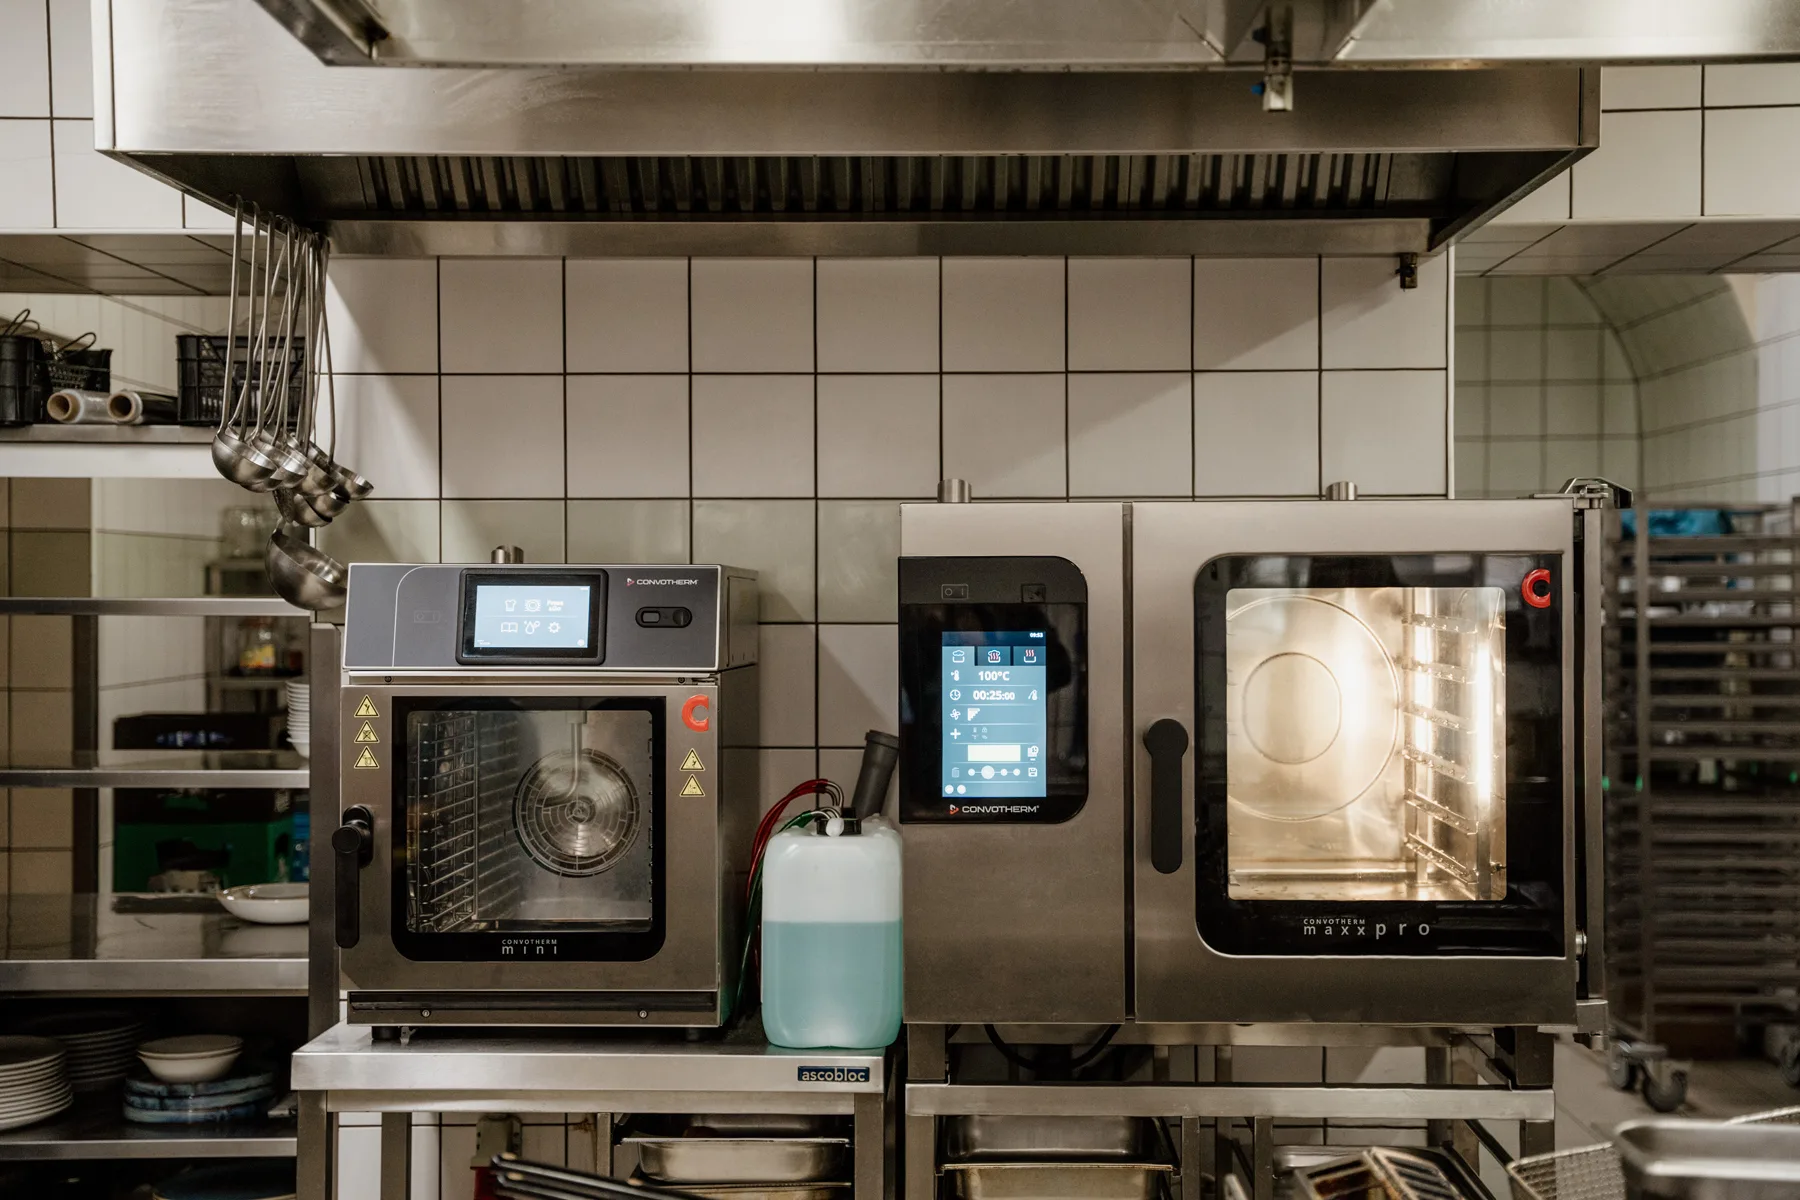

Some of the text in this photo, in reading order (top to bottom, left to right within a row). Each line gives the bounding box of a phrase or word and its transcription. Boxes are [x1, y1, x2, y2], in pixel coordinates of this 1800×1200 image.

[978, 670, 1010, 681] 100°C
[973, 690, 1015, 701] 00:25:00
[961, 805, 1038, 813] CONVOTHERM
[1375, 923, 1430, 940] pro
[801, 1067, 866, 1082] ascobloc
